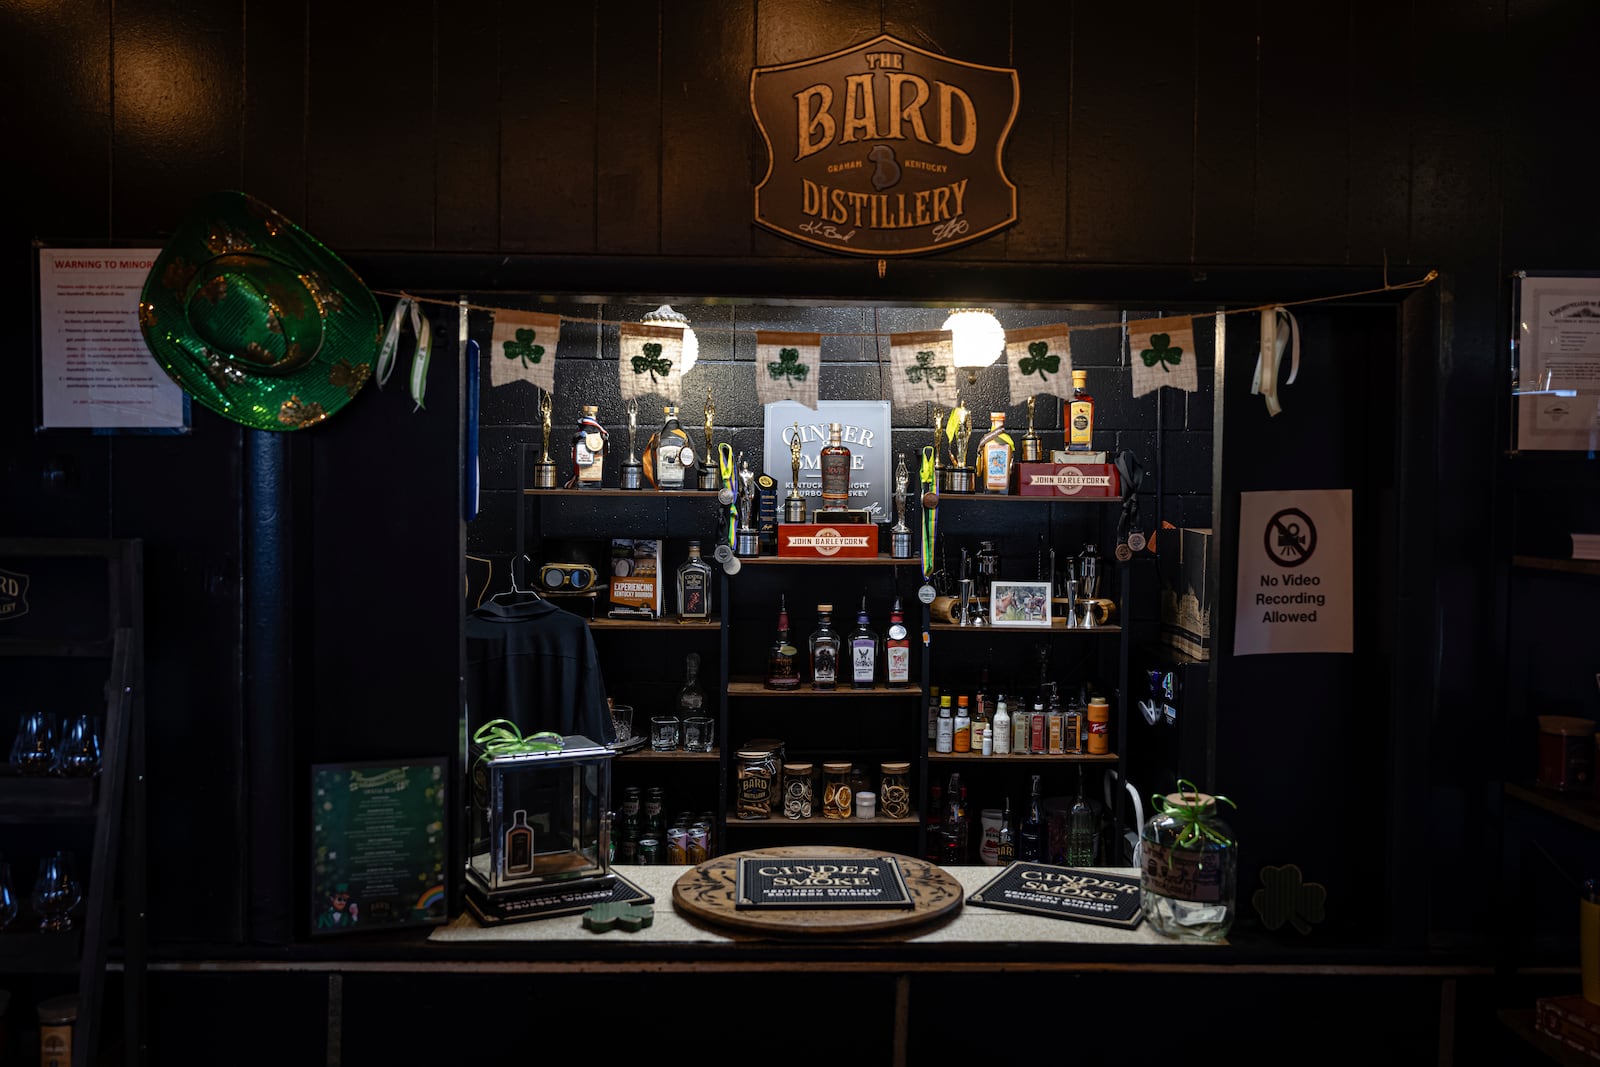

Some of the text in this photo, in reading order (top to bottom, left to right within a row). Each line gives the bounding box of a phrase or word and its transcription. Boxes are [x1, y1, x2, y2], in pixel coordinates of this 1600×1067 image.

[865, 53, 904, 70] THE
[793, 72, 978, 162] BARD
[827, 160, 948, 173] GRAHAM KENTUCKY
[802, 178, 969, 229] DISTILLERY
[54, 260, 154, 269] WARNING TO MINOR
[782, 424, 874, 448] CINER
[1260, 574, 1320, 586] No Video
[614, 582, 653, 592] EXPERIENCING
[1256, 592, 1325, 606] Recording
[1262, 610, 1317, 623] Allowed
[743, 778, 767, 790] BARD
[758, 865, 880, 876] CINDER
[773, 877, 870, 886] SMOKE
[1021, 871, 1139, 894] CINDER
[1022, 881, 1117, 901] SMOKE
